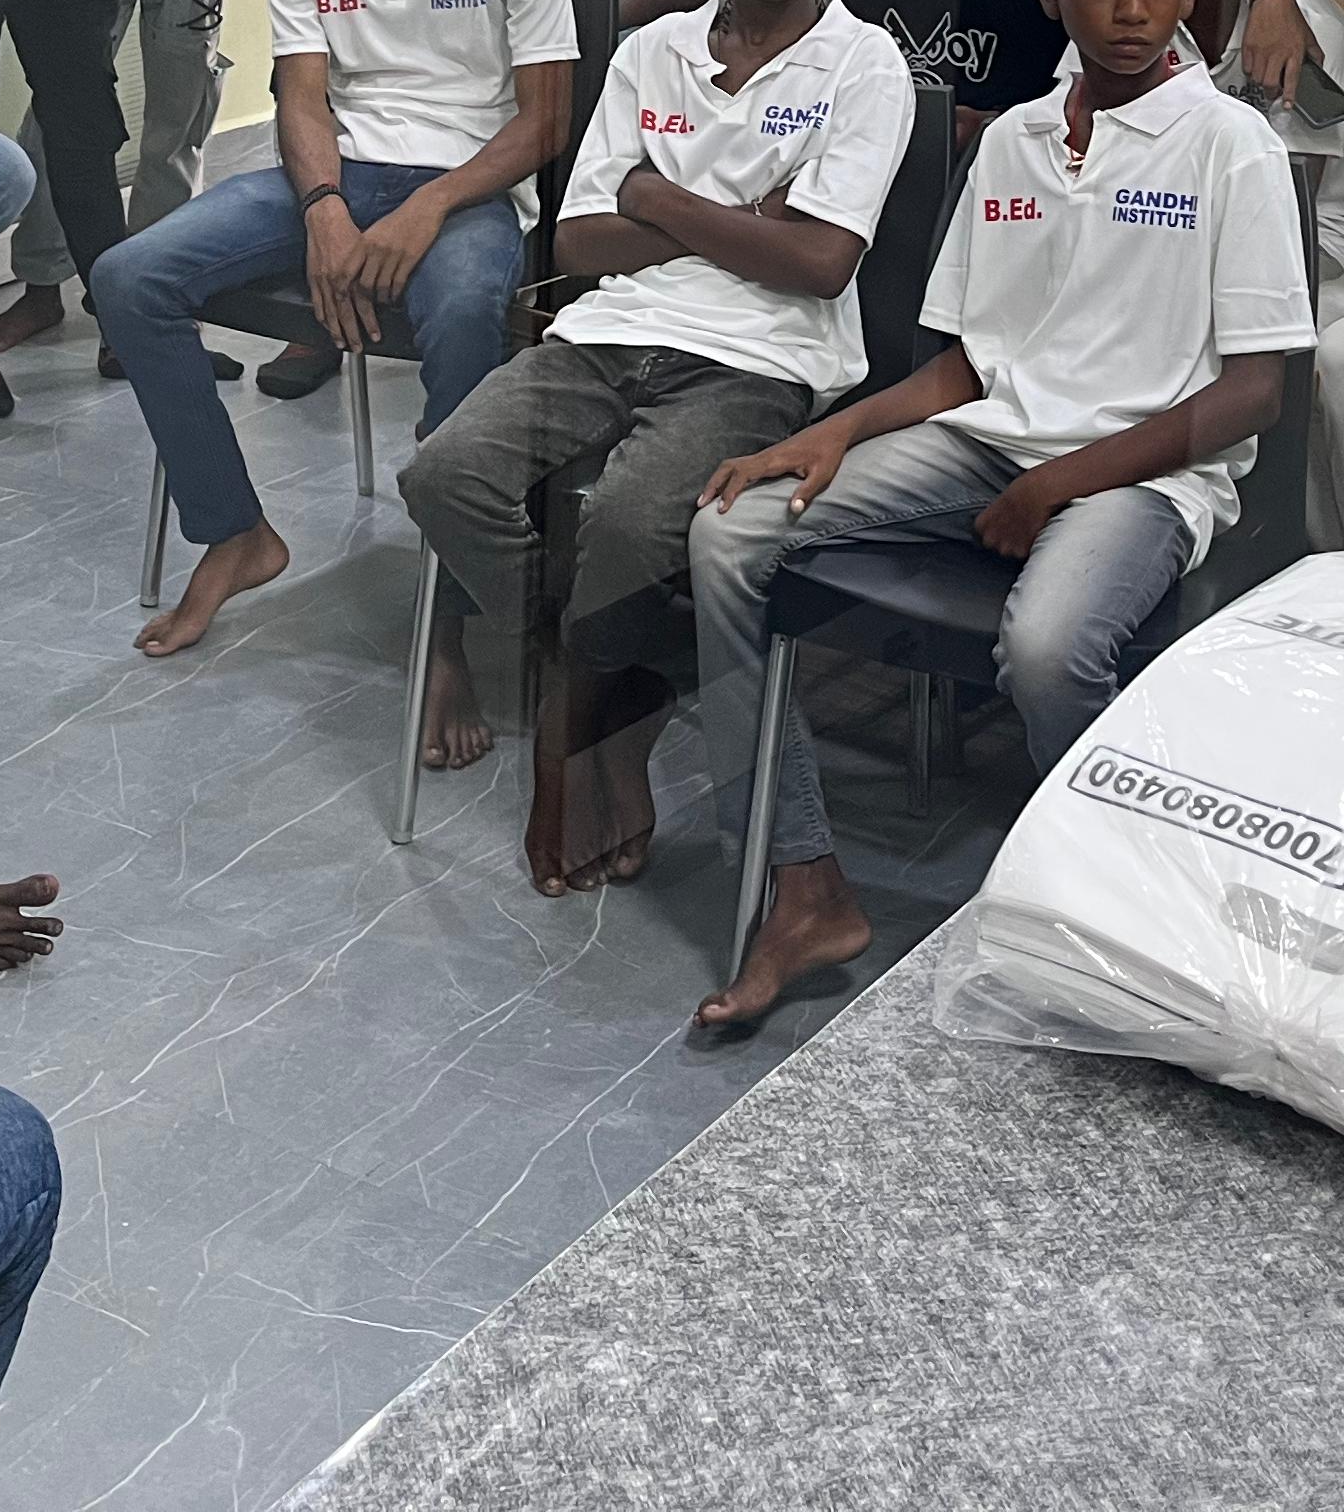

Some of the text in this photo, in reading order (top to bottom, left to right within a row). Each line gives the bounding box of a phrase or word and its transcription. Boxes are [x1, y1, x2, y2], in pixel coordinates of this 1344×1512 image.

[984, 196, 1042, 222] B.Ed.
[1115, 188, 1198, 212] GANDHI
[1112, 206, 1196, 230] INSTITUTE
[1088, 758, 1342, 875] 7008080490
